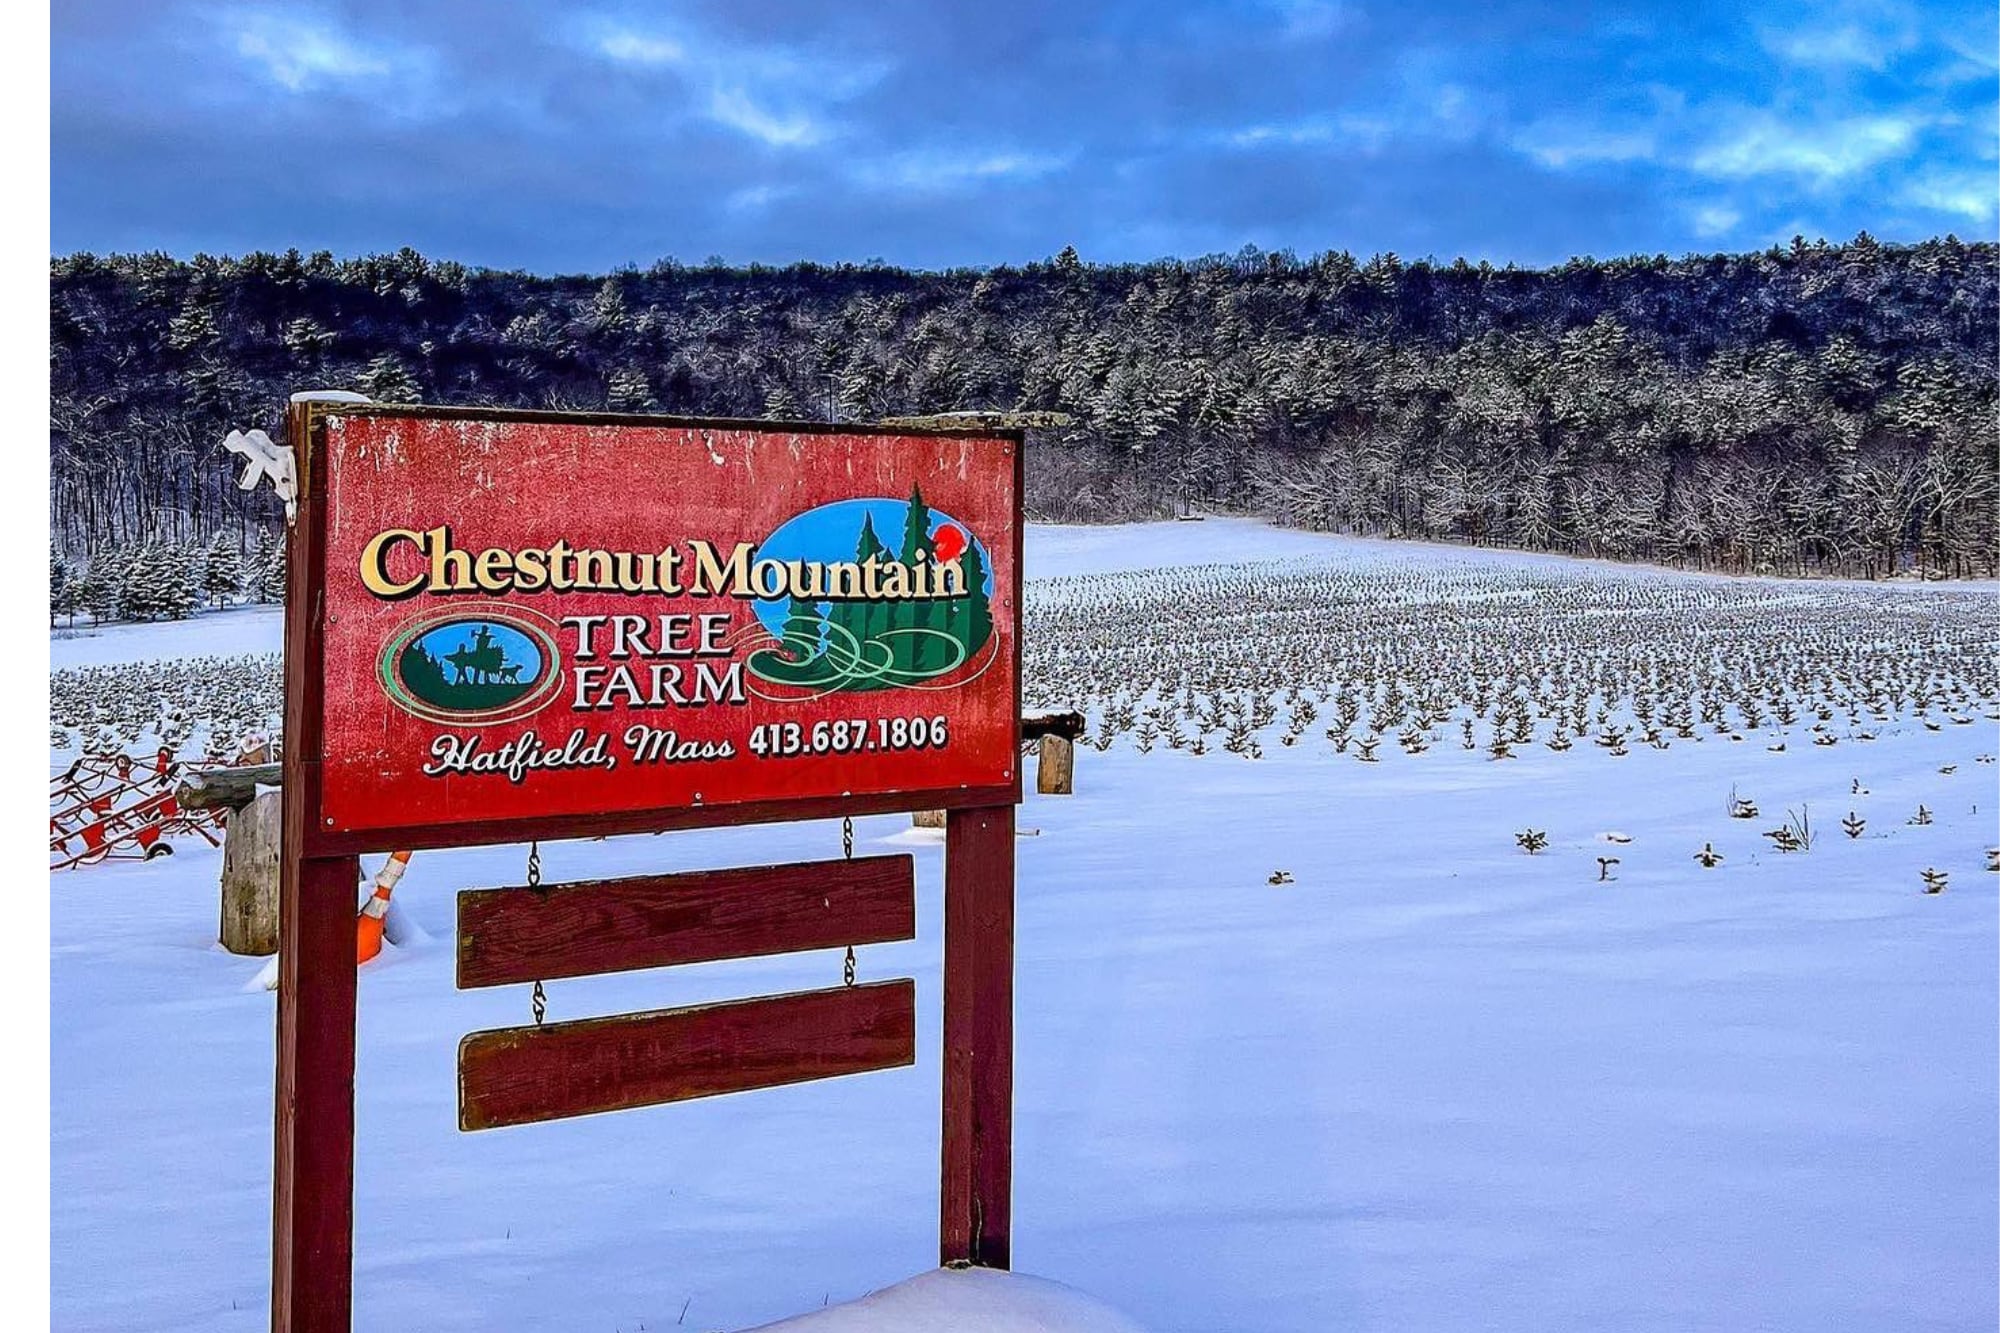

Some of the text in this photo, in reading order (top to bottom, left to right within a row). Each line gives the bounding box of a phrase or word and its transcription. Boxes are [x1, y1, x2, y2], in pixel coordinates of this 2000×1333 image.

[359, 525, 968, 597] Chestnut Mountain
[563, 613, 733, 657] TREE
[572, 661, 746, 708] FARM
[423, 716, 947, 782] Hatfield, Mass 413.687.1806
